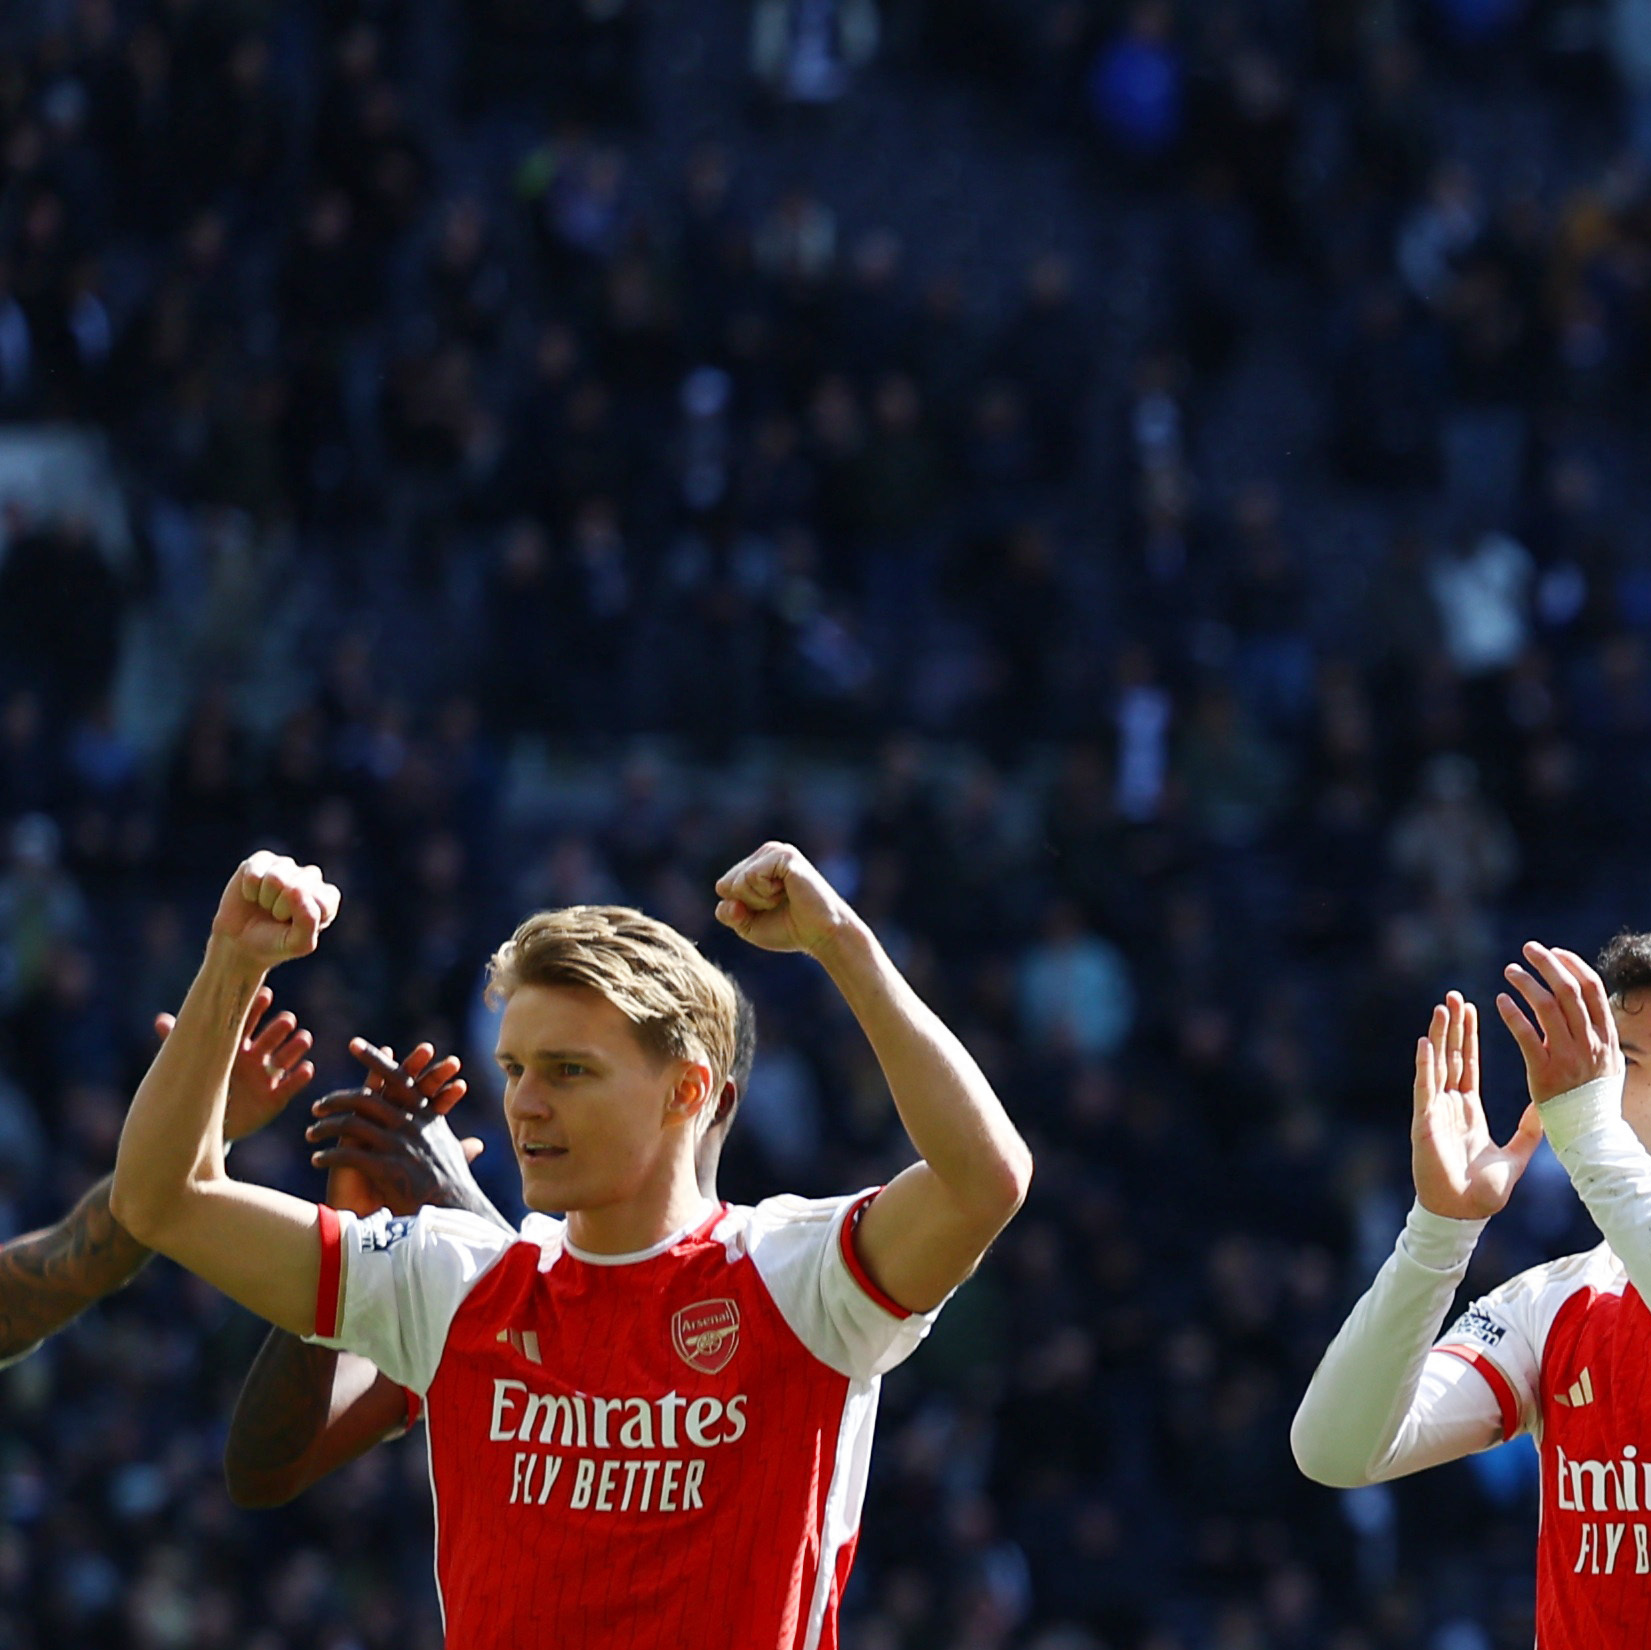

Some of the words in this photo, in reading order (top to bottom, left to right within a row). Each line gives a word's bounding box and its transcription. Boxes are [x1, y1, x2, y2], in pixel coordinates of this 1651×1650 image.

[490, 1378, 748, 1449] Emirates
[510, 1452, 562, 1505] FLY
[570, 1456, 706, 1513] BETTER
[1574, 1522, 1626, 1575] FLY
